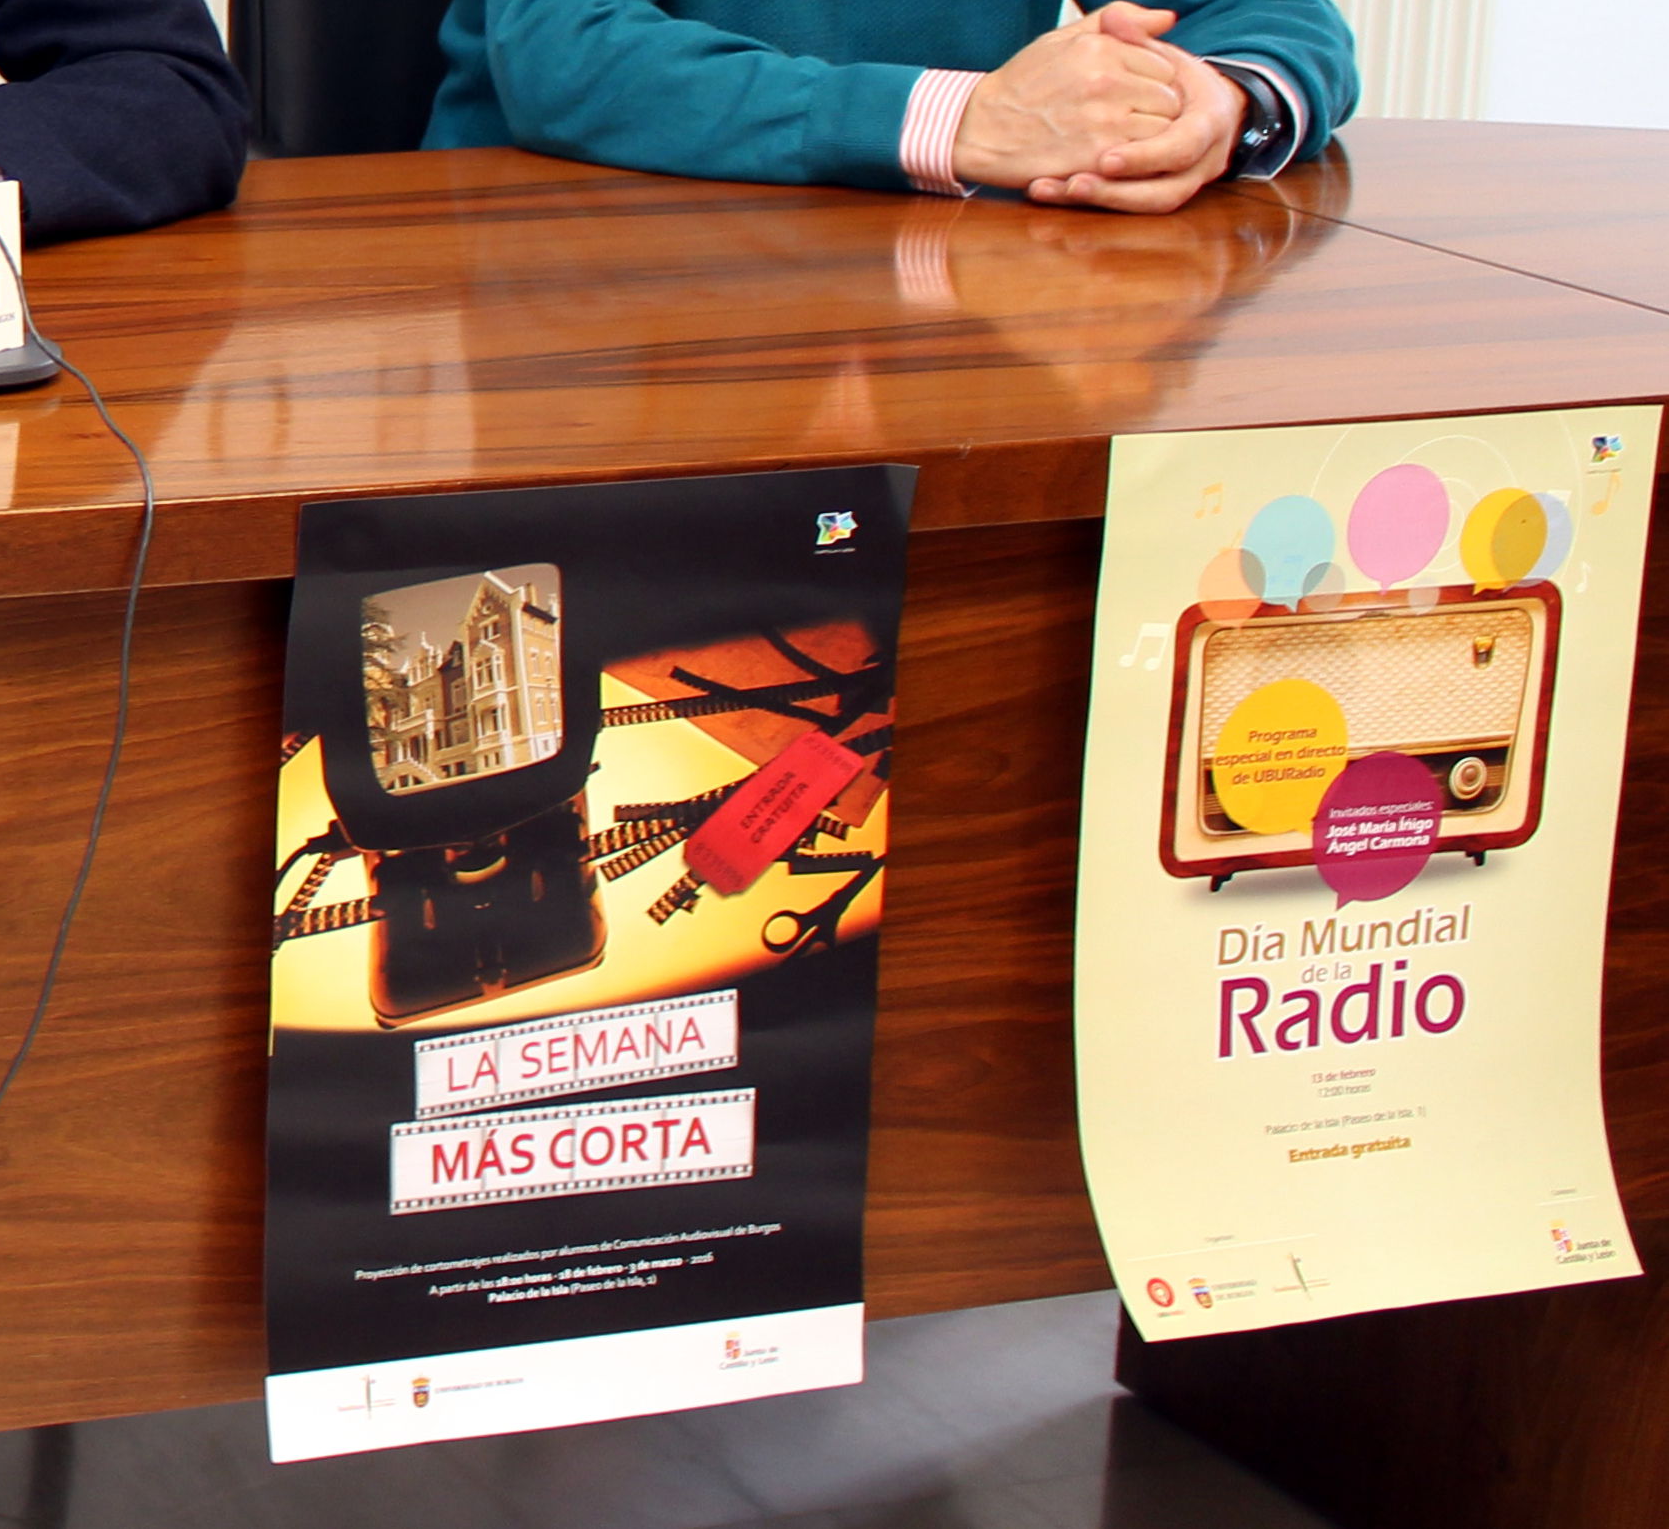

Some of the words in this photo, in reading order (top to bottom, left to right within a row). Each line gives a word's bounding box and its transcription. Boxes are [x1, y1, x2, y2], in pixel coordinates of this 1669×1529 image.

[1247, 728, 1318, 745] Programa
[1215, 750, 1272, 768] especial
[1275, 749, 1293, 761] en
[1296, 745, 1347, 760] directo
[1232, 773, 1251, 785] de
[1253, 766, 1326, 784] UBURadio
[739, 771, 797, 829] ENTRADA
[1328, 804, 1377, 819] Invitados
[1325, 823, 1356, 839] José
[1326, 836, 1368, 856] Ángel
[1369, 835, 1430, 851] Carmona
[1217, 925, 1286, 966] Día
[1299, 904, 1471, 957] Mundial
[1301, 964, 1328, 984] de
[1333, 962, 1353, 981] la
[1218, 959, 1466, 1059] Radio
[447, 1051, 500, 1093] LA
[520, 1016, 705, 1079] SEMANA
[431, 1128, 536, 1185] MÁS
[549, 1117, 712, 1169] CORTA
[1288, 1143, 1349, 1164] Entrada
[1351, 1136, 1412, 1159] gratuita
